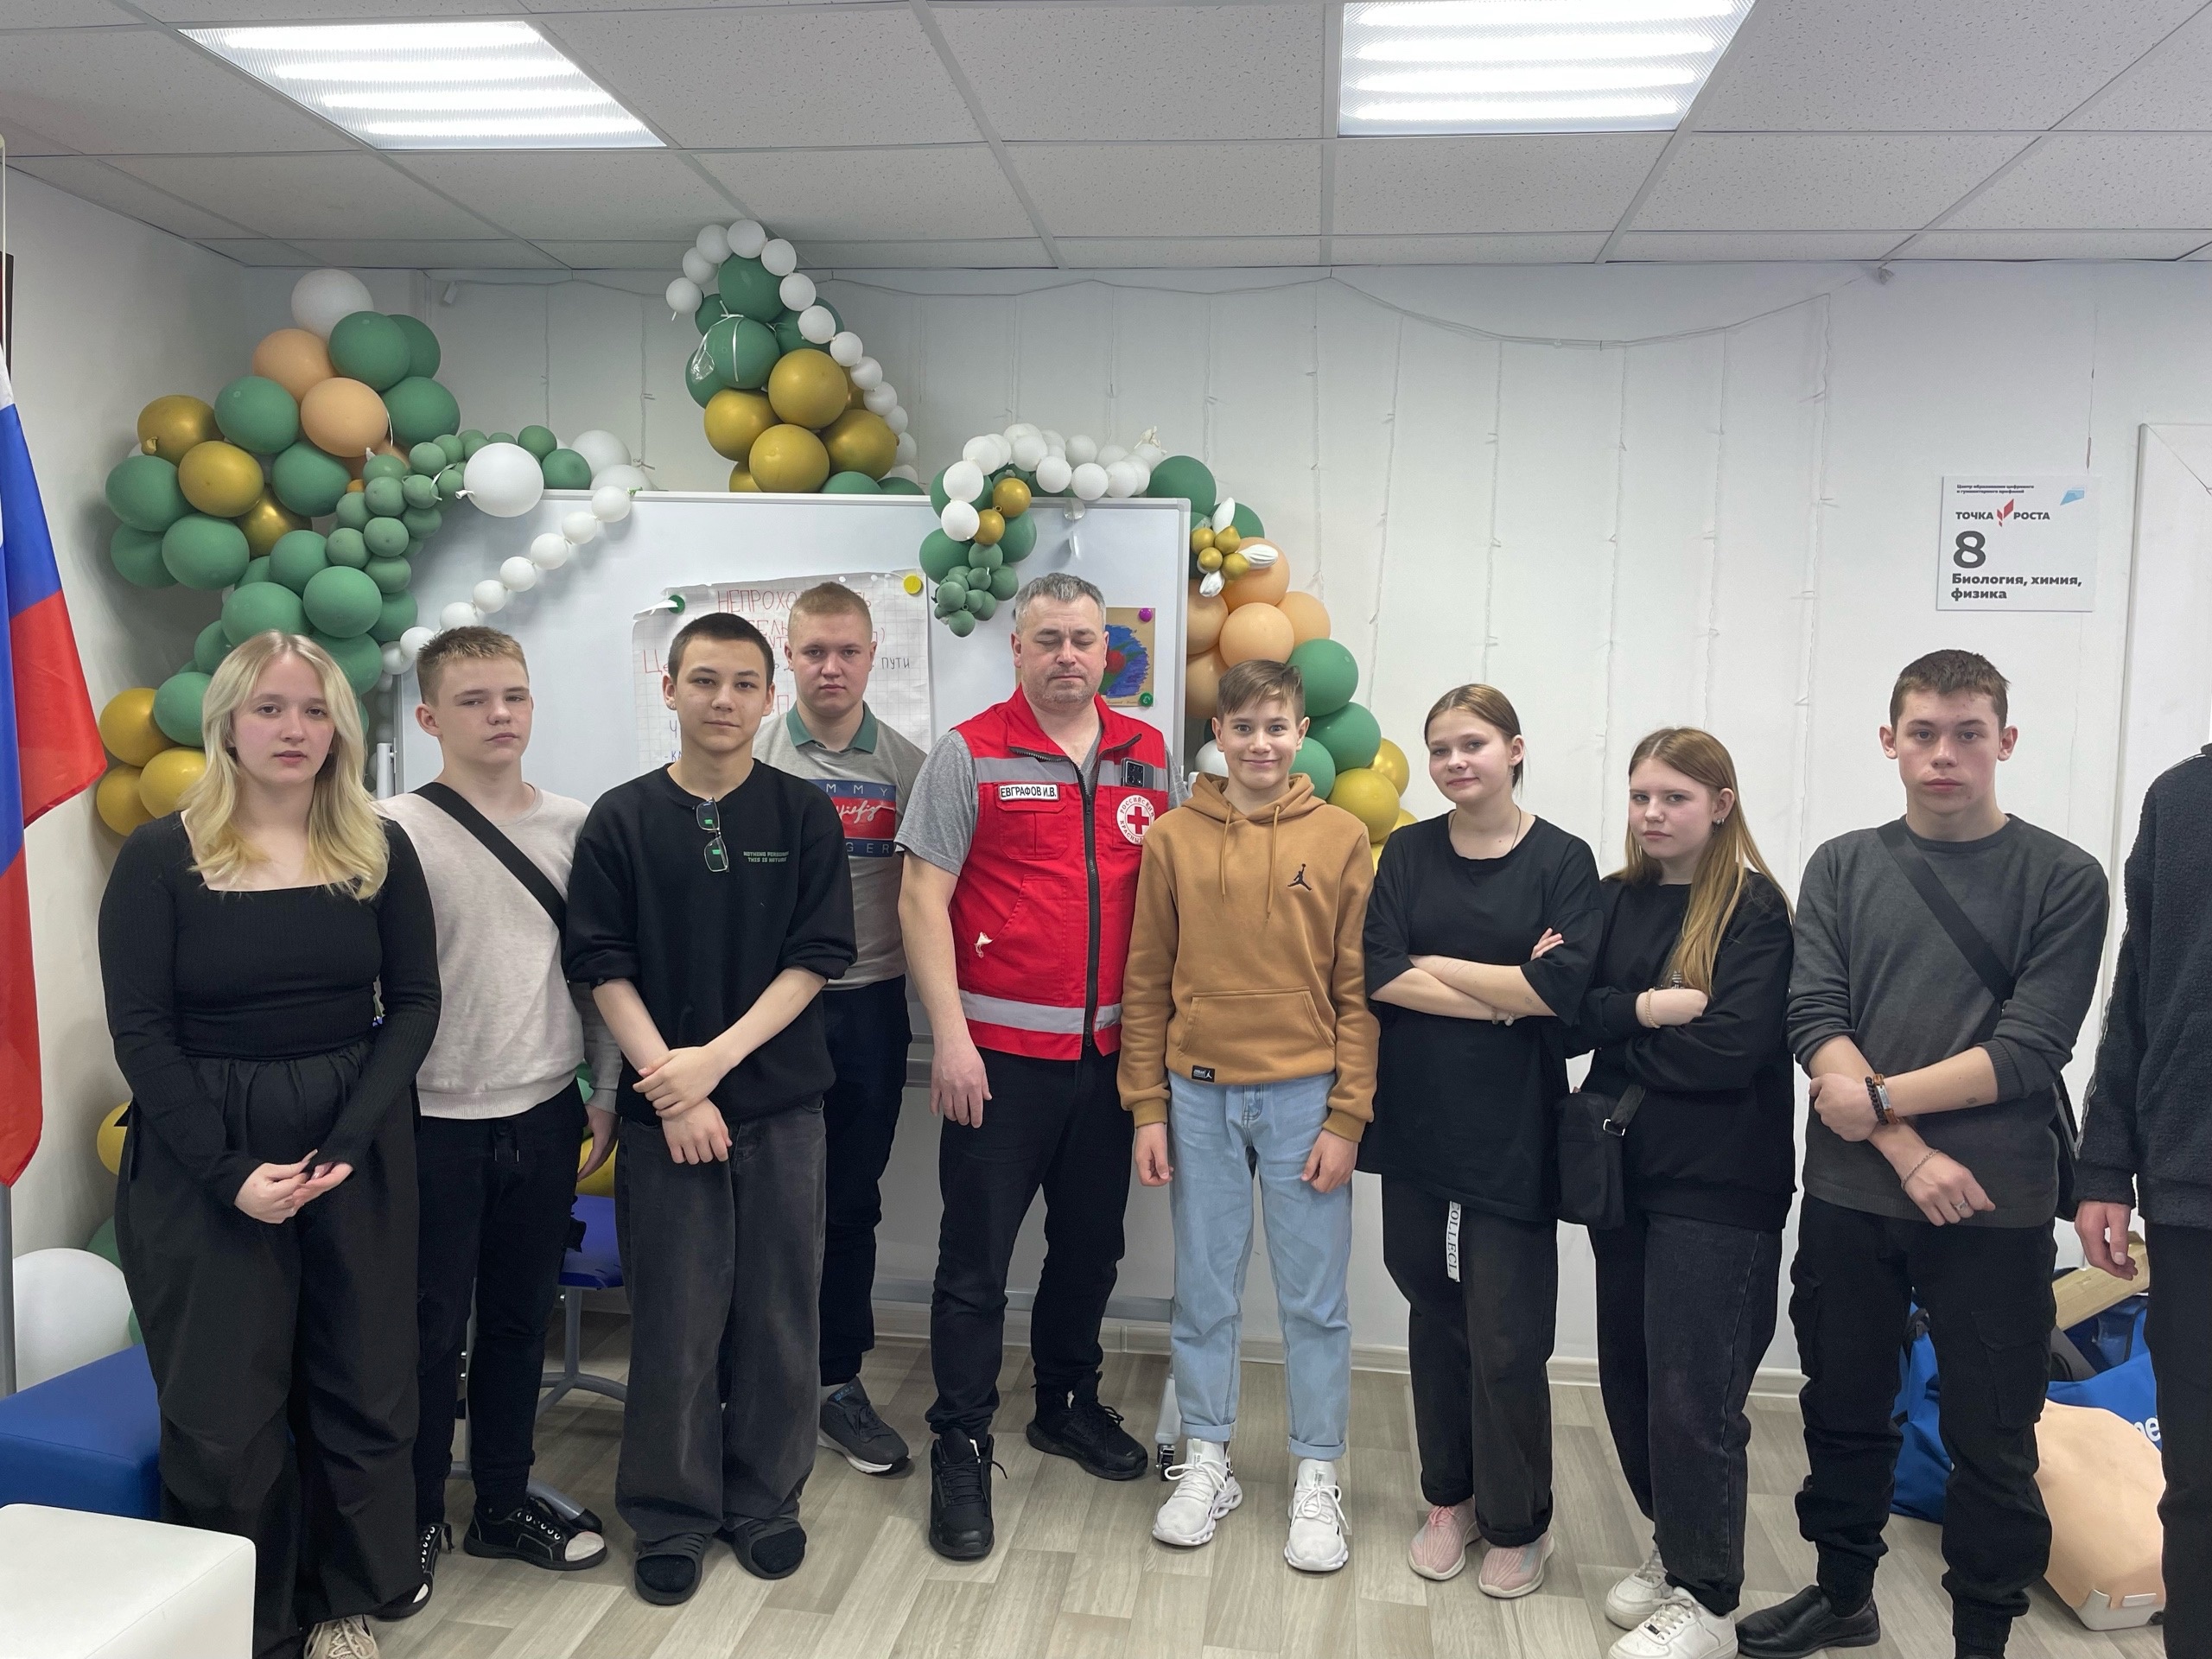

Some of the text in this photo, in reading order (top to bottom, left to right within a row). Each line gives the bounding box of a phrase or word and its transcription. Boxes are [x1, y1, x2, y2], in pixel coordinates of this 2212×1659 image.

[1955, 512, 2050, 520] ТОЧКА РОСТА
[1953, 530, 1986, 569] 8
[1952, 573, 2082, 588] Биология, химия,
[1951, 588, 2007, 601] физика
[881, 657, 910, 670] ПУТИ
[1001, 785, 1057, 798] ЕВГРАФОВ И.В.
